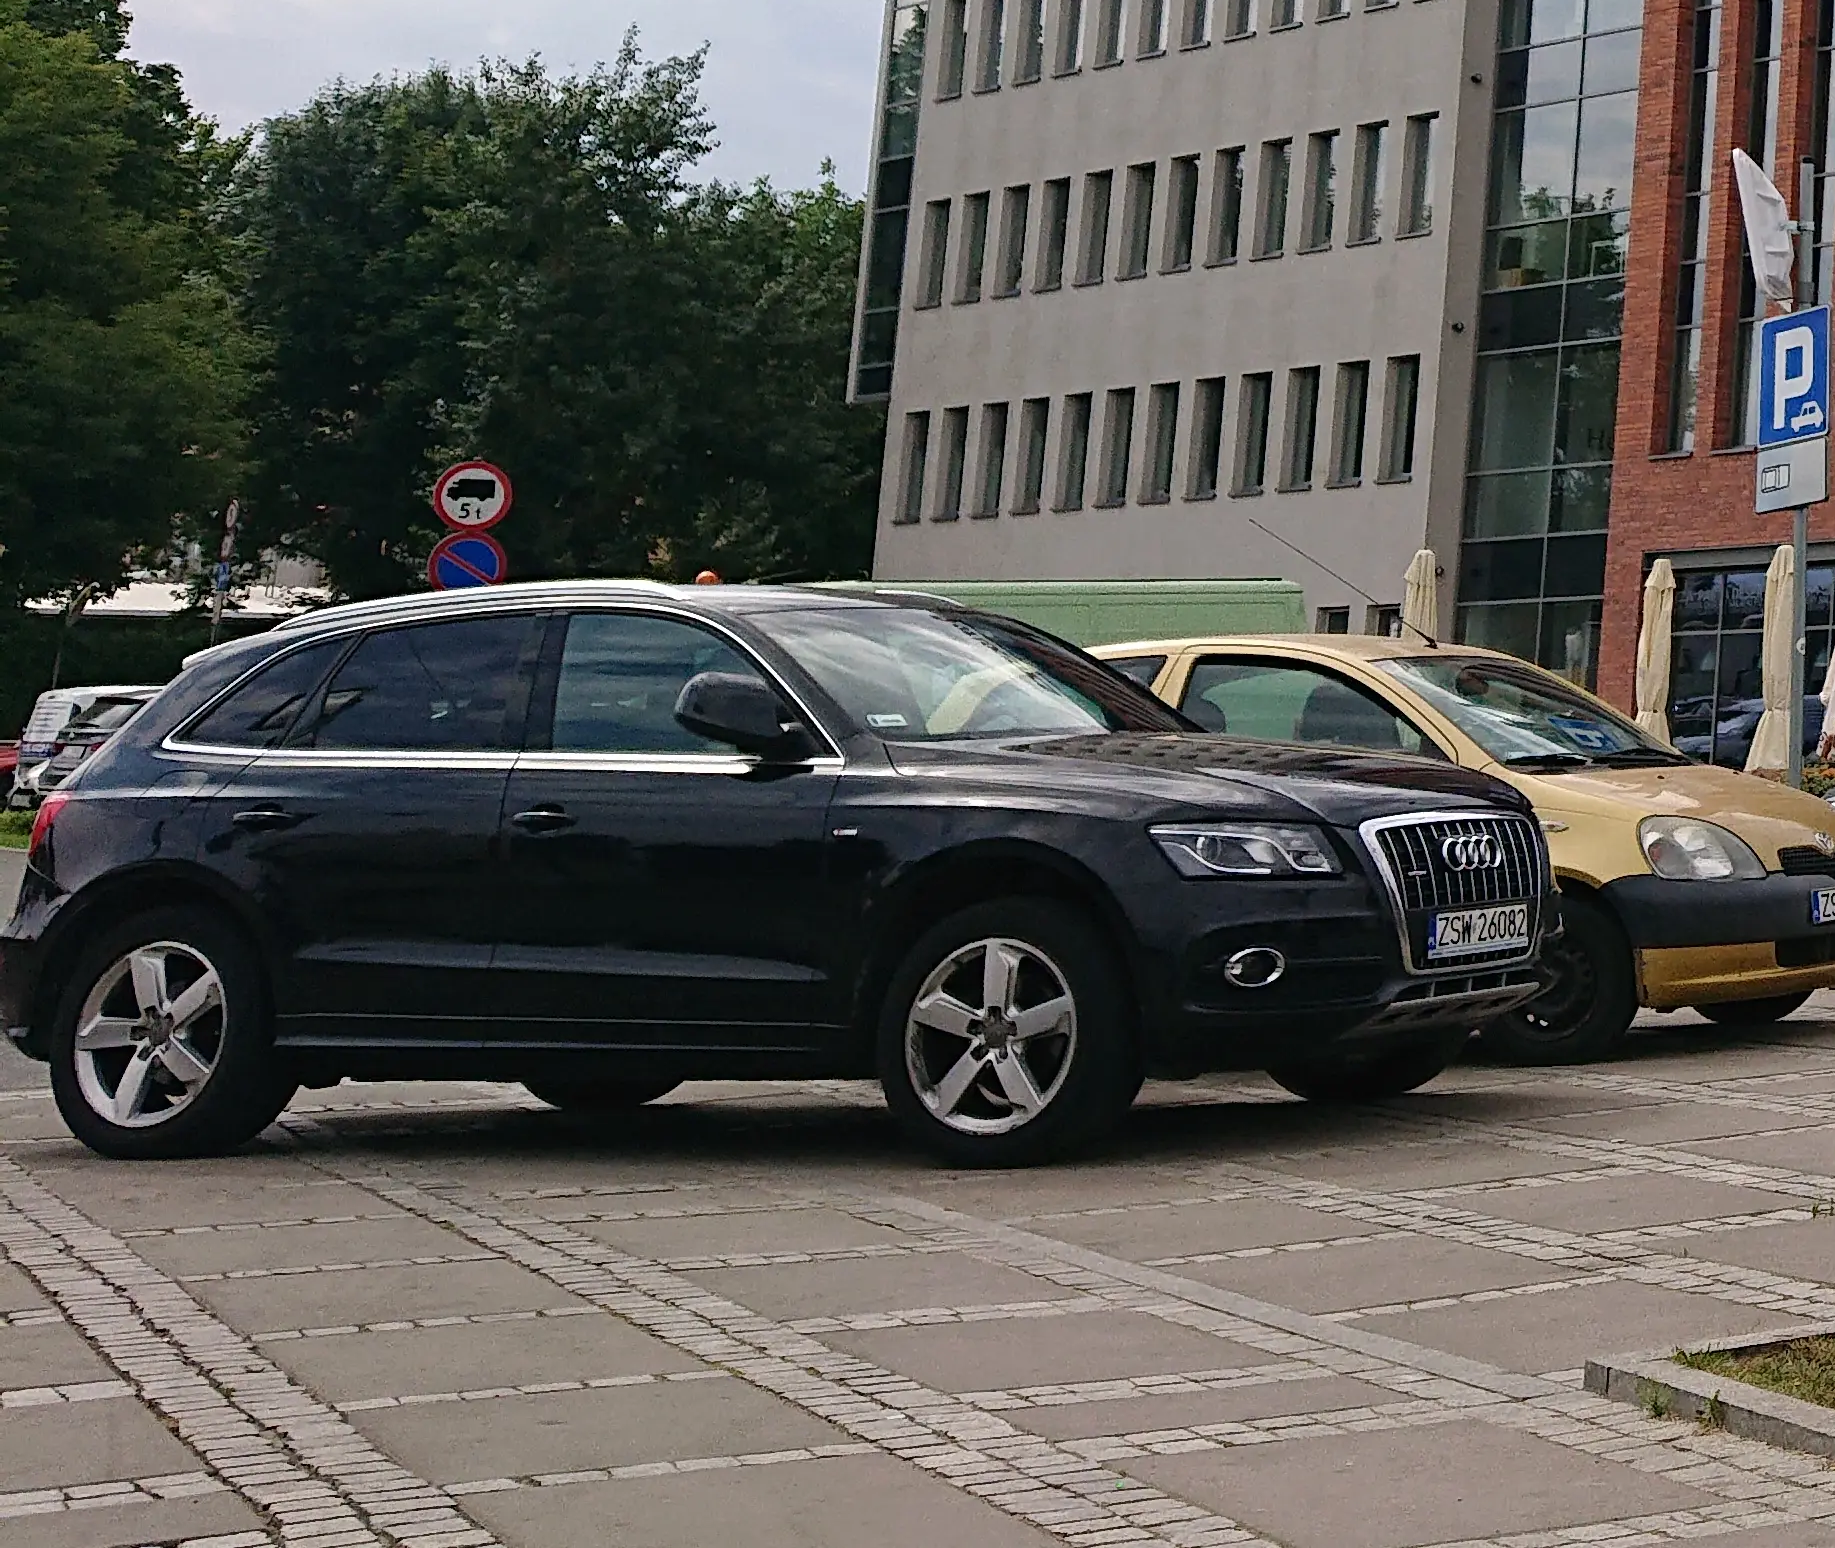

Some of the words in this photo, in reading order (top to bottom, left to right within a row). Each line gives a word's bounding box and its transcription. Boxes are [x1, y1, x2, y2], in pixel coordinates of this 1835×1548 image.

[458, 503, 471, 519] 5
[475, 508, 481, 520] t
[1438, 913, 1473, 947] ZSW
[1477, 908, 1526, 942] 26082
